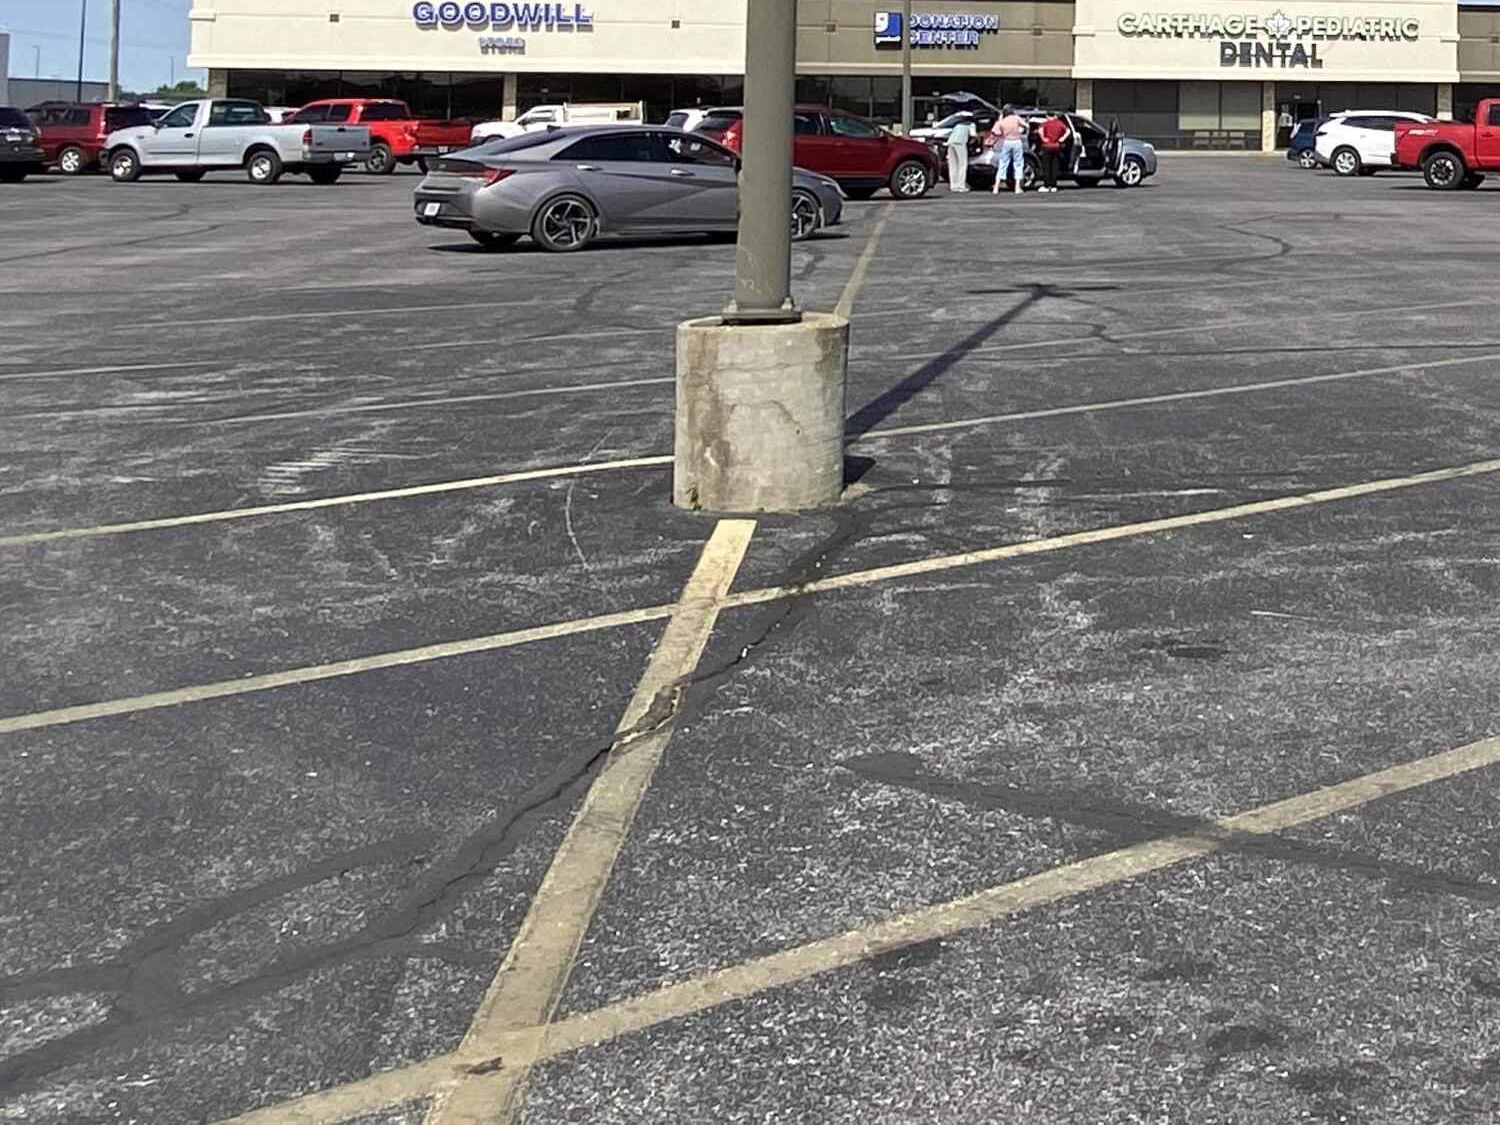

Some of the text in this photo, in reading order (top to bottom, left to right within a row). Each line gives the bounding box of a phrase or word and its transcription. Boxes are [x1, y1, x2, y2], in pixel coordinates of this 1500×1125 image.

[412, 1, 595, 28] GOODWILL
[910, 14, 999, 30] DONATION
[1117, 13, 1420, 40] CARTHAGE PEDIATRIC
[1220, 42, 1323, 68] DENTAL
